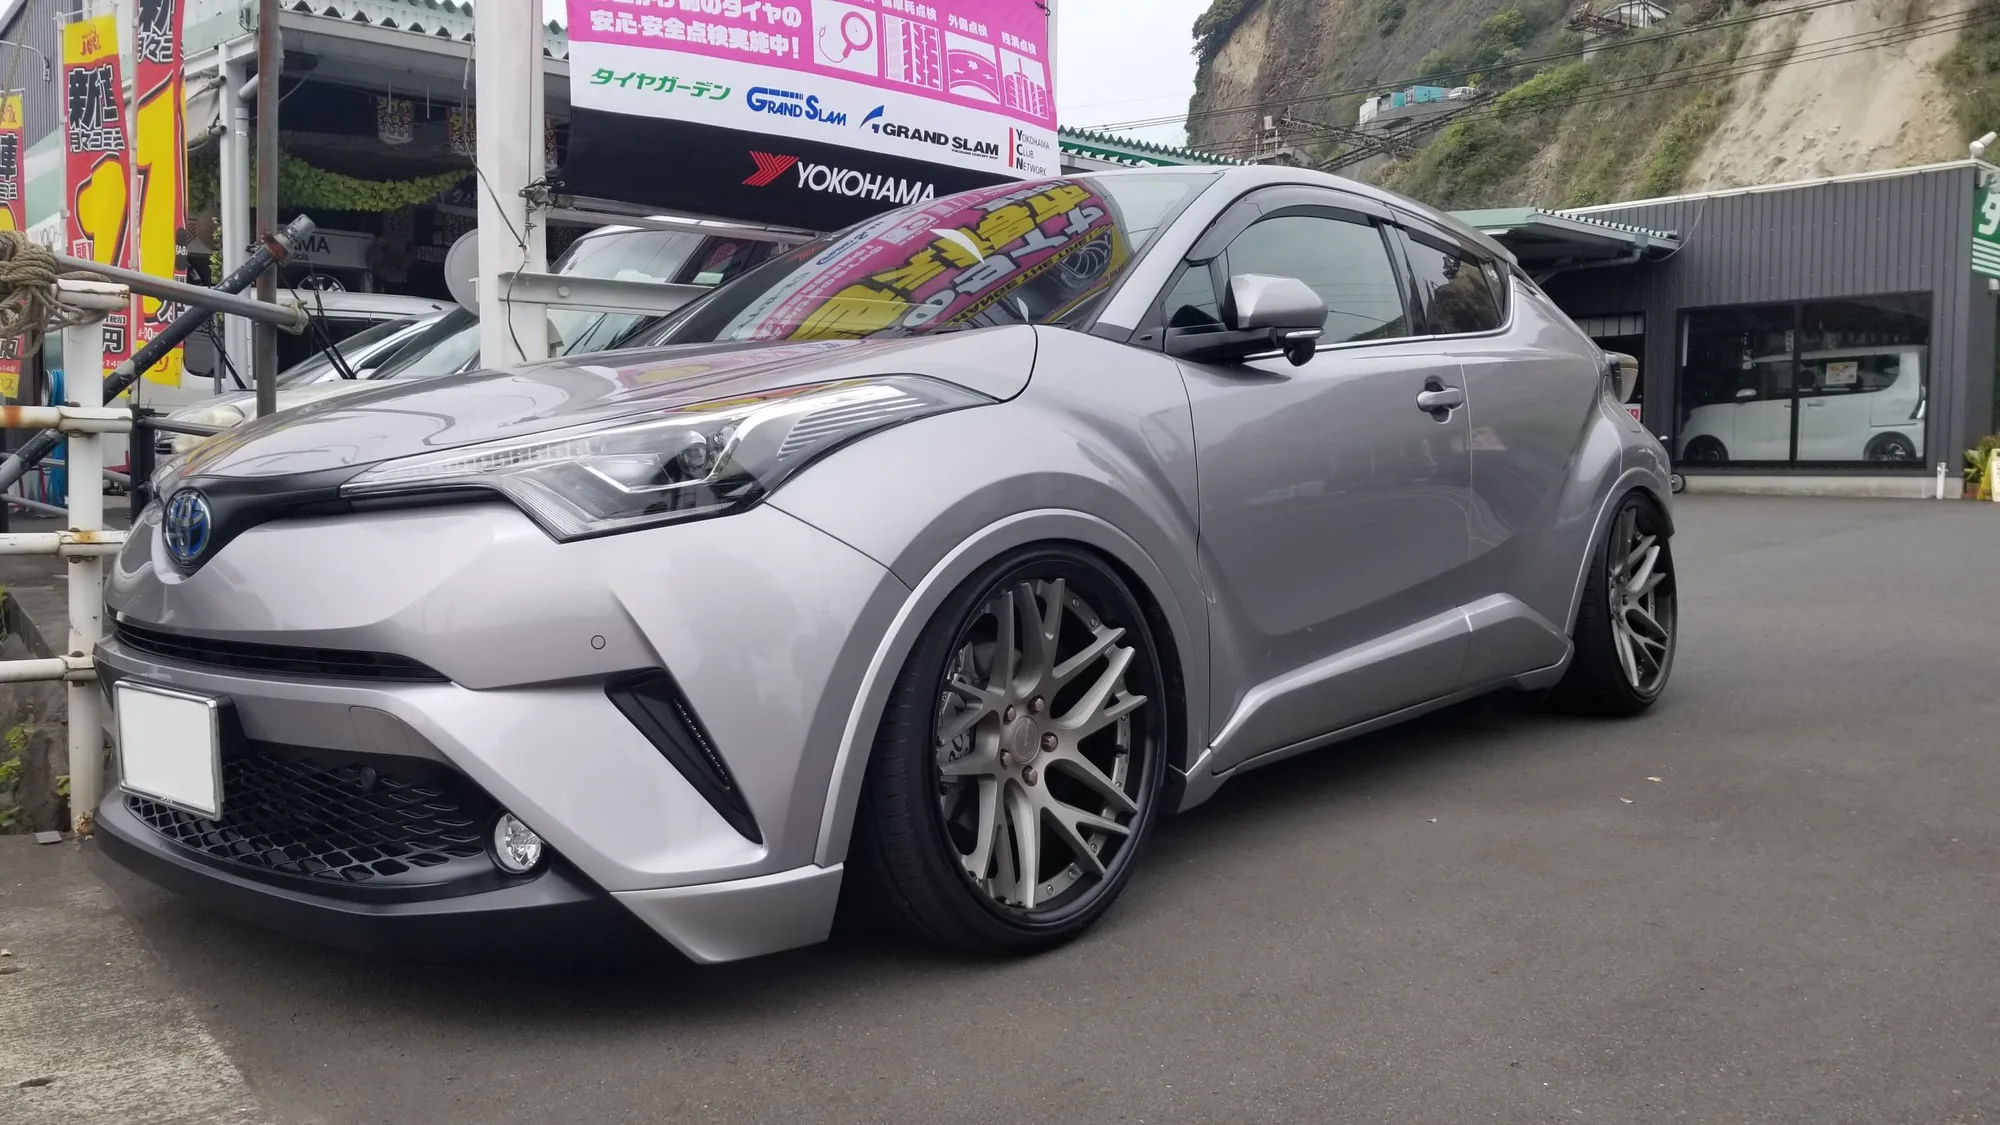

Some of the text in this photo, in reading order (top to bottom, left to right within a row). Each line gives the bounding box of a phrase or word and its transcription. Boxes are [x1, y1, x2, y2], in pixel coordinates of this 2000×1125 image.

[612, 0, 802, 28] 前のタイヤの
[589, 67, 731, 101] タイヤガーデン
[746, 86, 847, 127] GRAND SLAM
[882, 122, 999, 156] GRAND SLAM
[1016, 128, 1050, 150] YOKOHAMA
[1016, 147, 1034, 159] CLUB
[1016, 157, 1046, 176] NETWORK
[798, 161, 935, 205] YOKOHAMA
